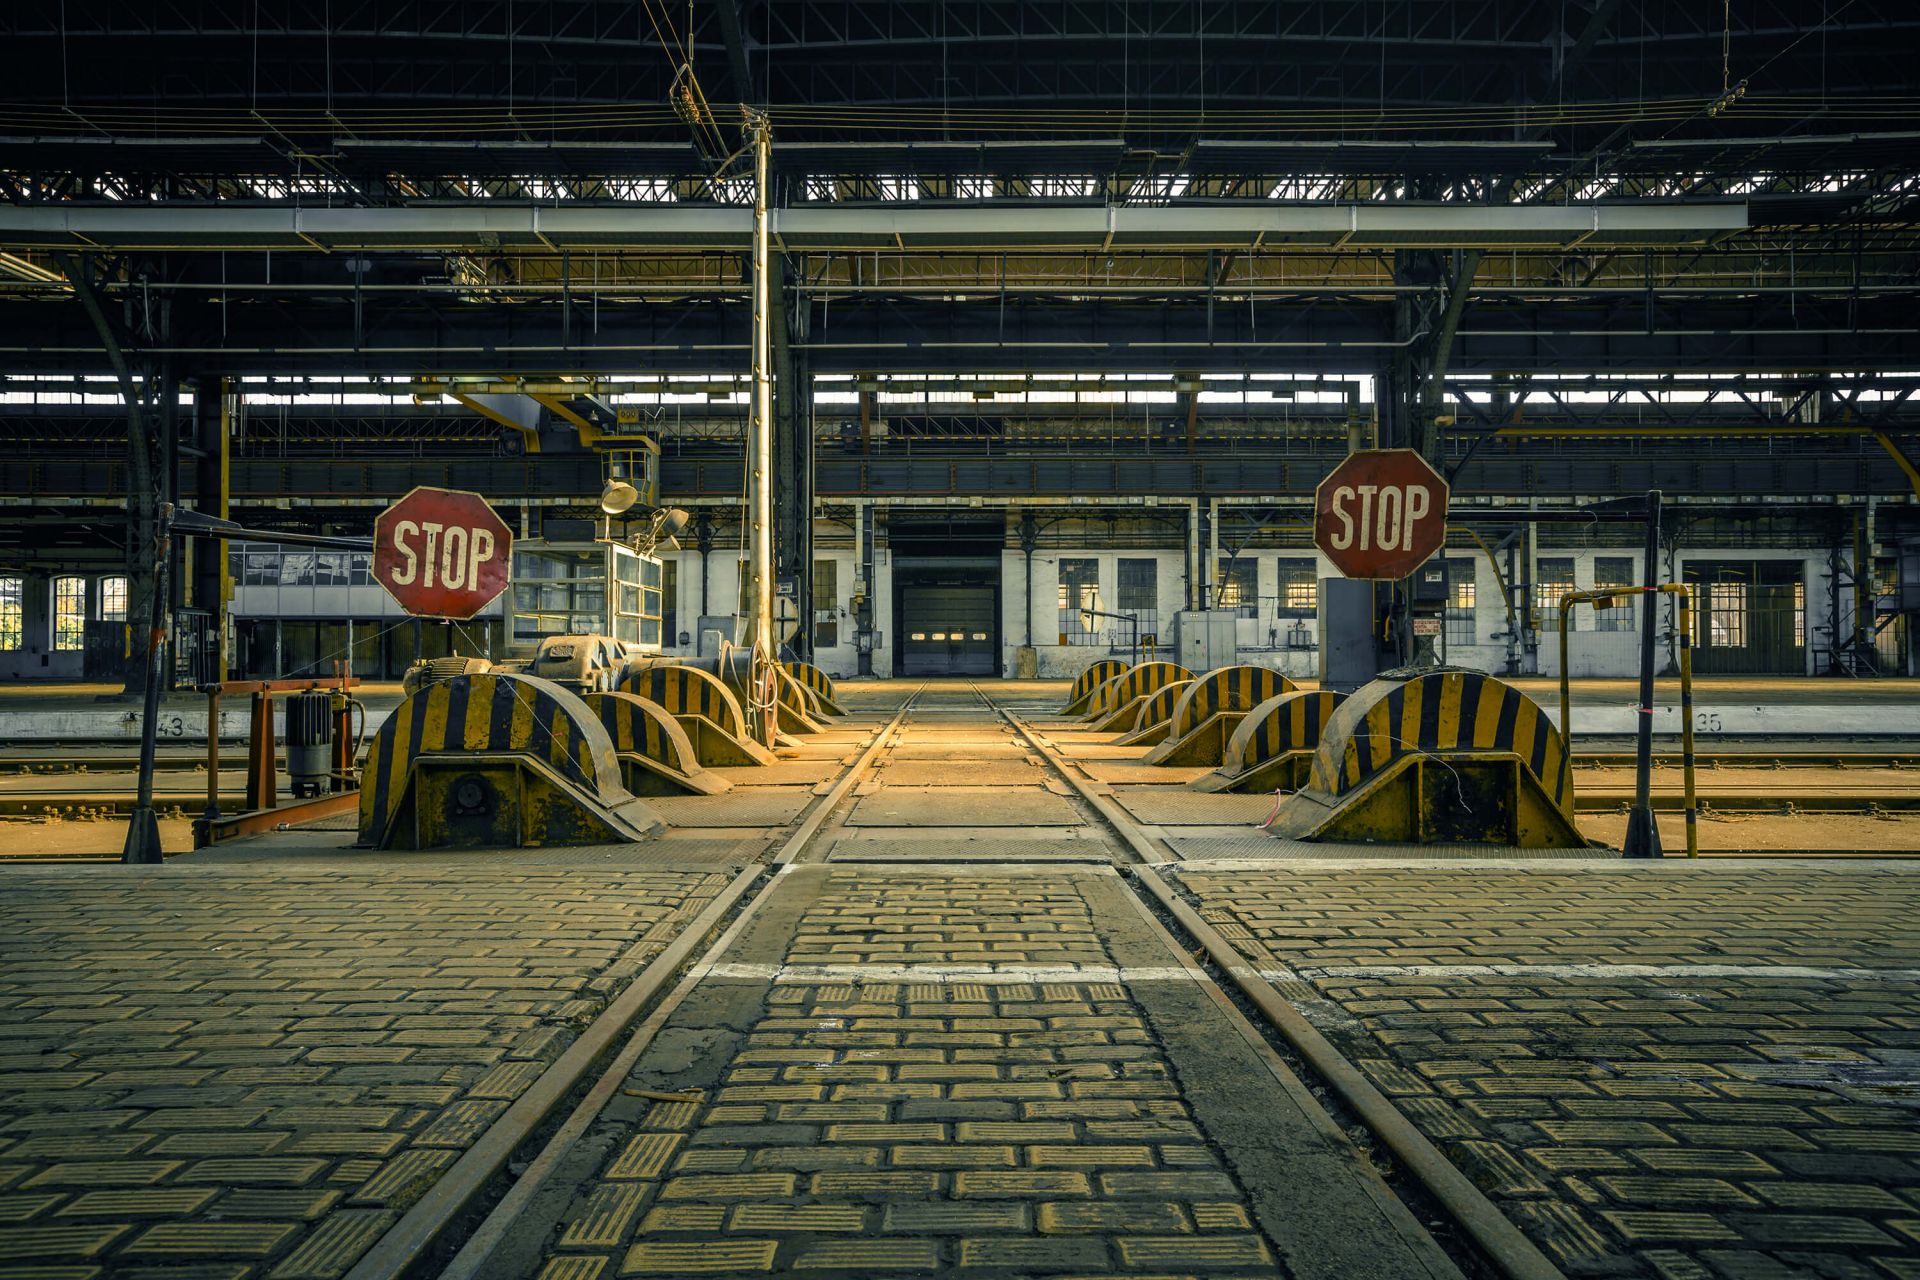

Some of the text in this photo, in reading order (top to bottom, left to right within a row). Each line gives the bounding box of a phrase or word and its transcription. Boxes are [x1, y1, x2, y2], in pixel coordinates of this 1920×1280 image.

[1330, 485, 1430, 552] STOP
[391, 520, 495, 592] STOP
[1696, 713, 1722, 732] 35
